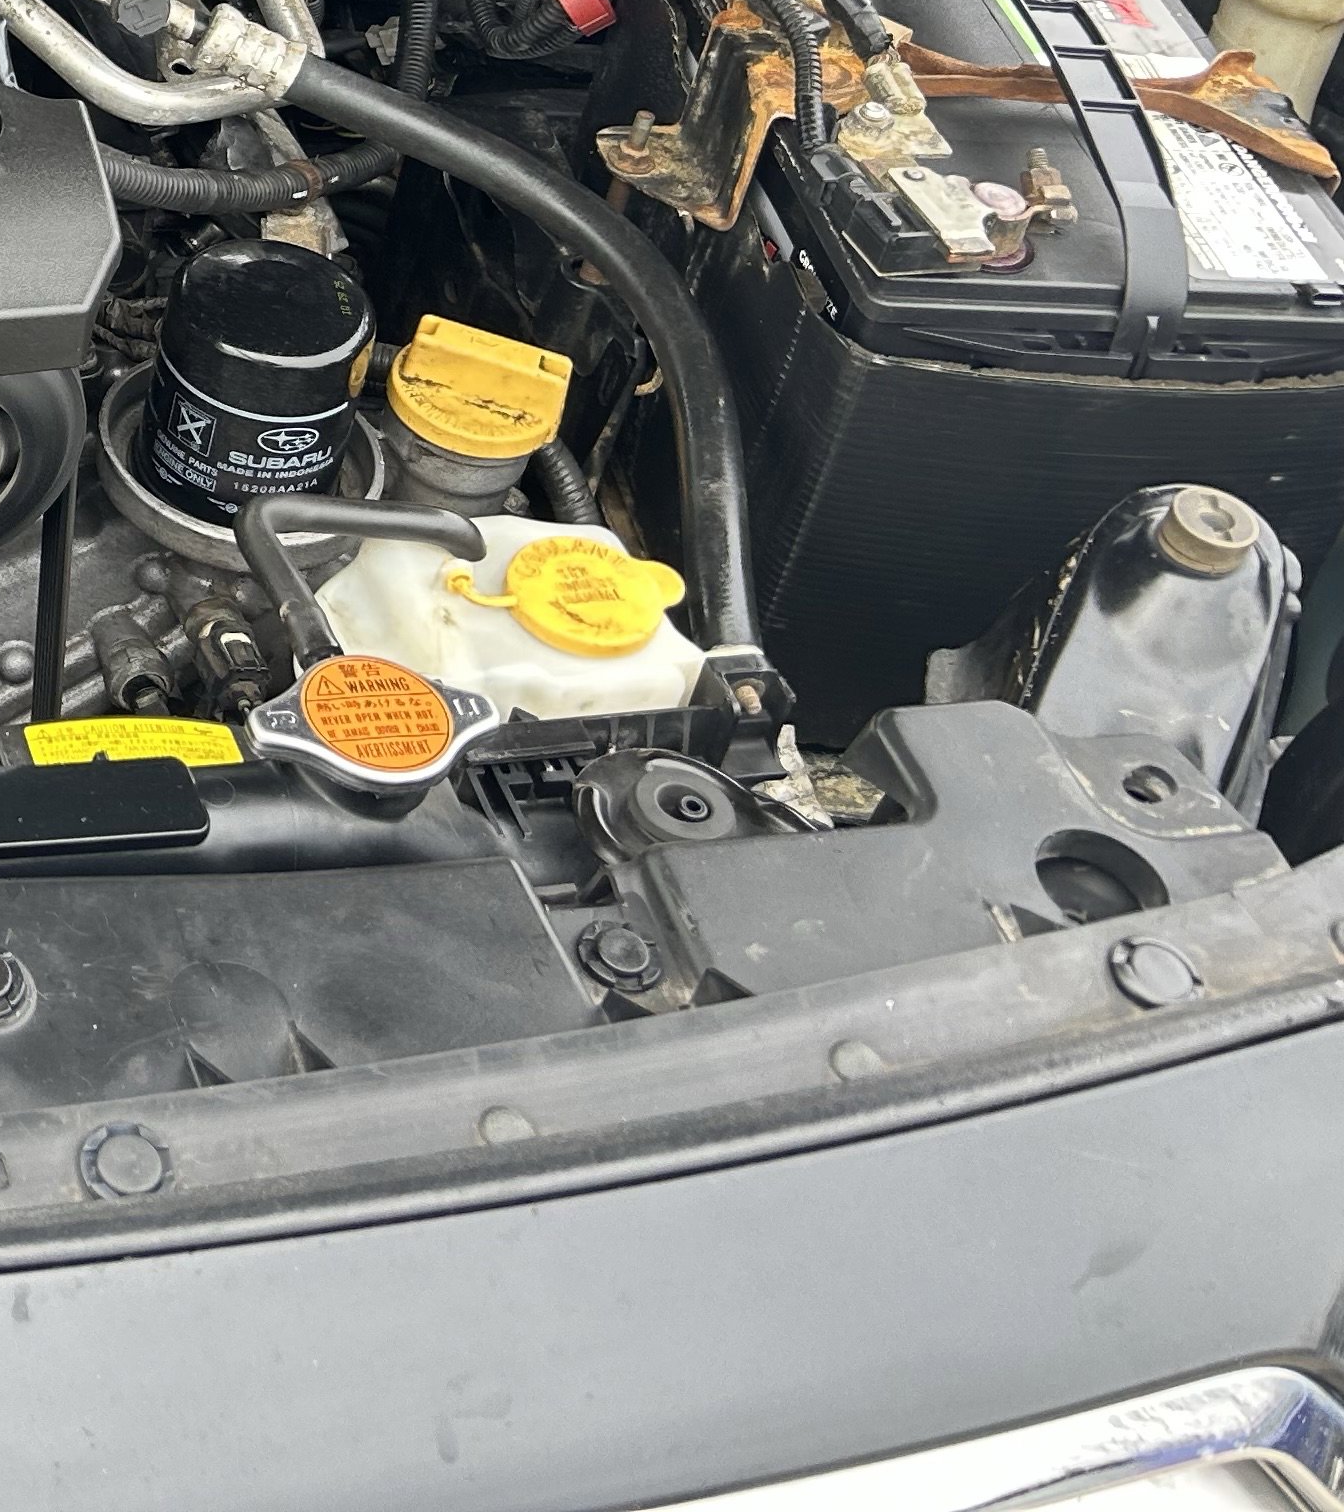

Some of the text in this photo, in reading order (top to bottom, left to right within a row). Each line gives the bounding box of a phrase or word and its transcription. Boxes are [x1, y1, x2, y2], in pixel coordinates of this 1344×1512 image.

[188, 457, 219, 477] PARTS
[228, 445, 333, 470] SUBARU
[216, 457, 334, 480] MADE IN INDONESIA
[185, 470, 213, 490] ONLY
[338, 663, 381, 678] 警告
[344, 676, 410, 694] WARNING
[321, 714, 352, 726] NEVER
[355, 712, 381, 724] OPEN
[385, 710, 412, 721] WHEN
[83, 724, 127, 735] CAUTION
[133, 724, 185, 734] ATTENTION
[356, 739, 432, 760] AVERTISSMENT
